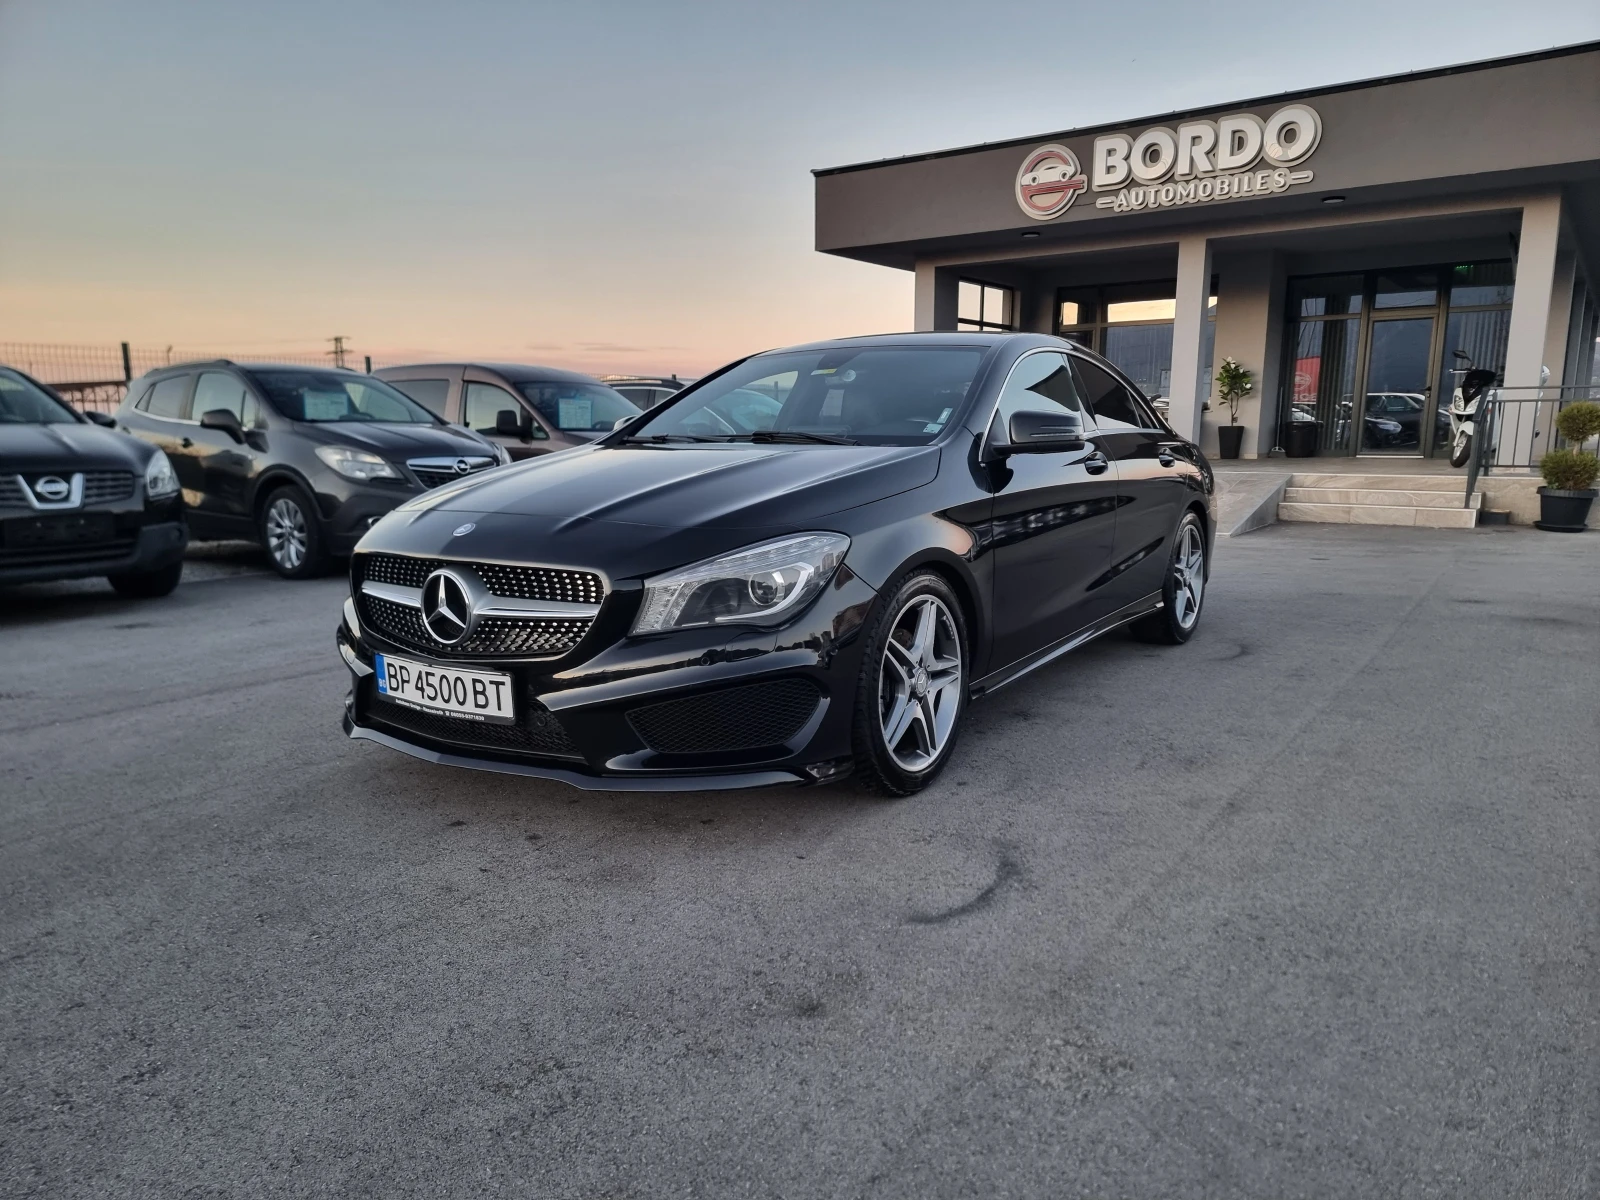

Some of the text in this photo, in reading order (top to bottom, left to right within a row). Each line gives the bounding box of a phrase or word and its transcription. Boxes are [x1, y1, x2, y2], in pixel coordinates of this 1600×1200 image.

[1094, 107, 1319, 187] BORDO
[1114, 170, 1287, 209] AUTOMOBILES
[386, 662, 506, 712] BP 4500 BT
